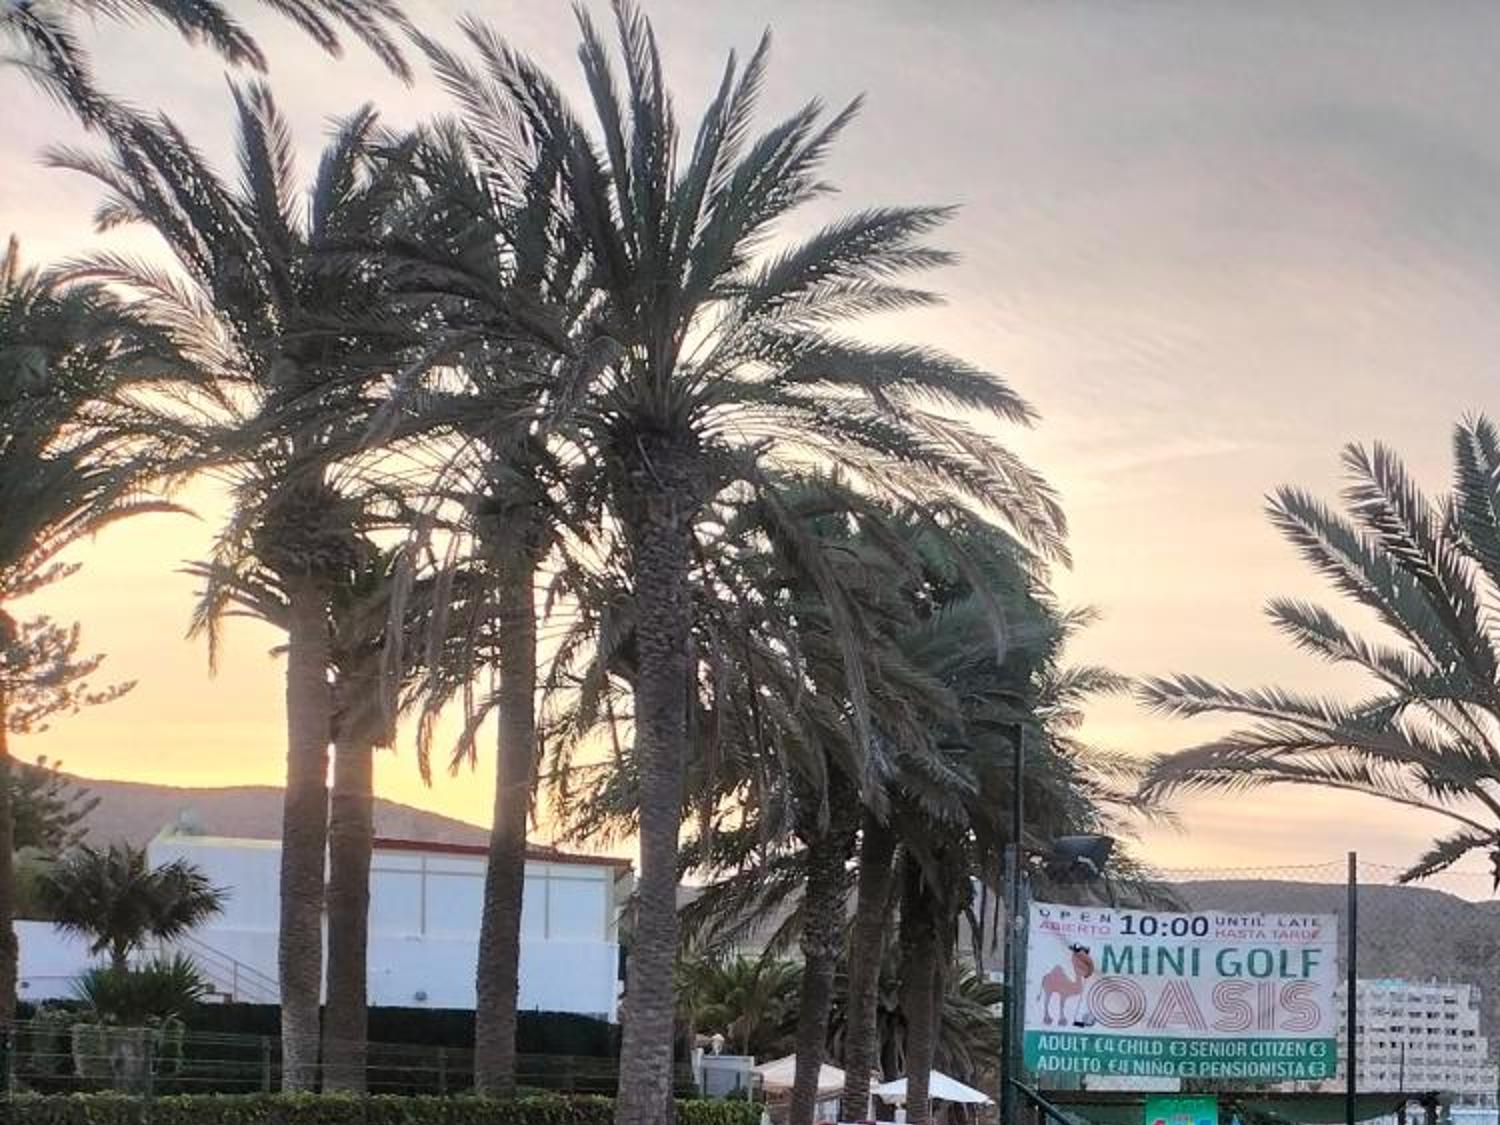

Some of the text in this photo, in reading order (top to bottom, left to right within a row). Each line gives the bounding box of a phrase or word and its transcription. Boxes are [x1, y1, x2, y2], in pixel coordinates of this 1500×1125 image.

[1039, 908, 1320, 937] OPEN 10:00 UNTIL LATE
[1039, 920, 1320, 940] ABIERTO HASTA TARDE
[1101, 943, 1322, 979] MINI GOLF
[1087, 976, 1322, 1032] OASIS
[1038, 1034, 1328, 1057] ADULT €4 CHILD €3 SENIOR CITIZEN €3
[1037, 1055, 1328, 1078] ADULTO €4 NIÑO €3 PENSIONISTA €3
